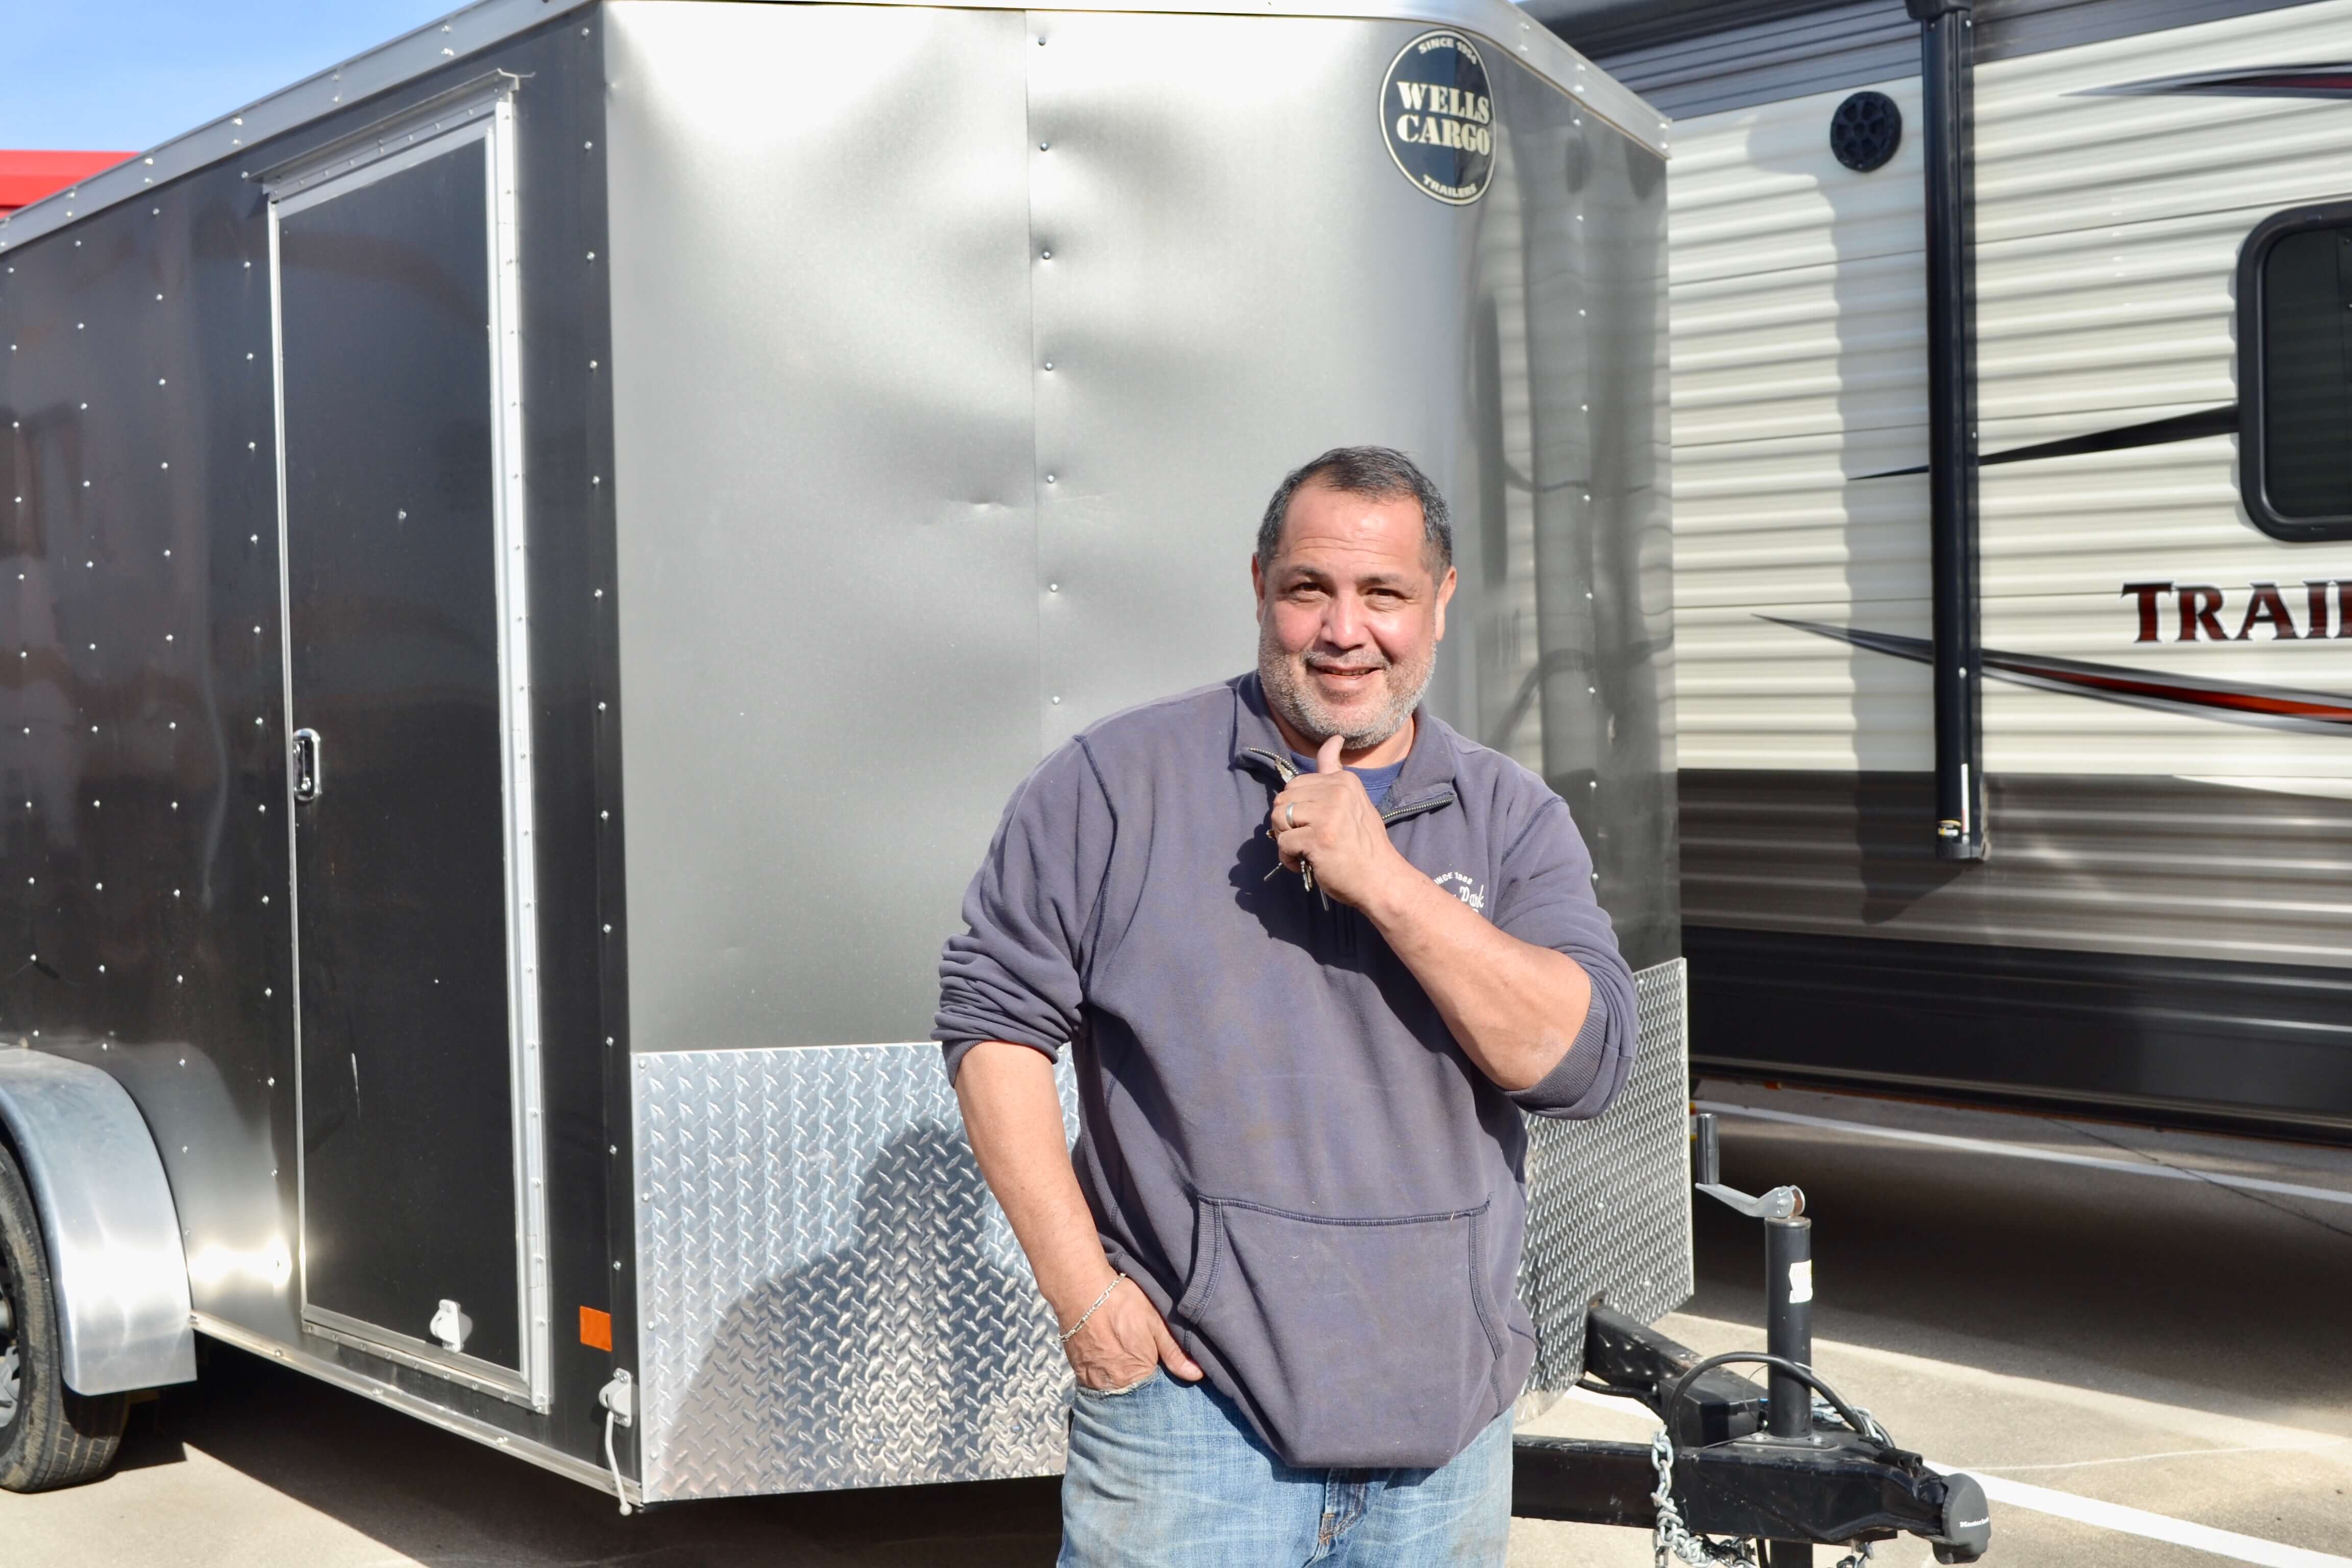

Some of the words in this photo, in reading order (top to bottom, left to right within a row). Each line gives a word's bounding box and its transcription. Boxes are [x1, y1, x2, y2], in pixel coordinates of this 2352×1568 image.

[1418, 37, 1454, 54] SINCE
[1396, 81, 1490, 125] WELLS
[1396, 114, 1490, 156] CARGO
[1423, 174, 1477, 198] TRAILERS
[1433, 872, 1453, 885] INCE
